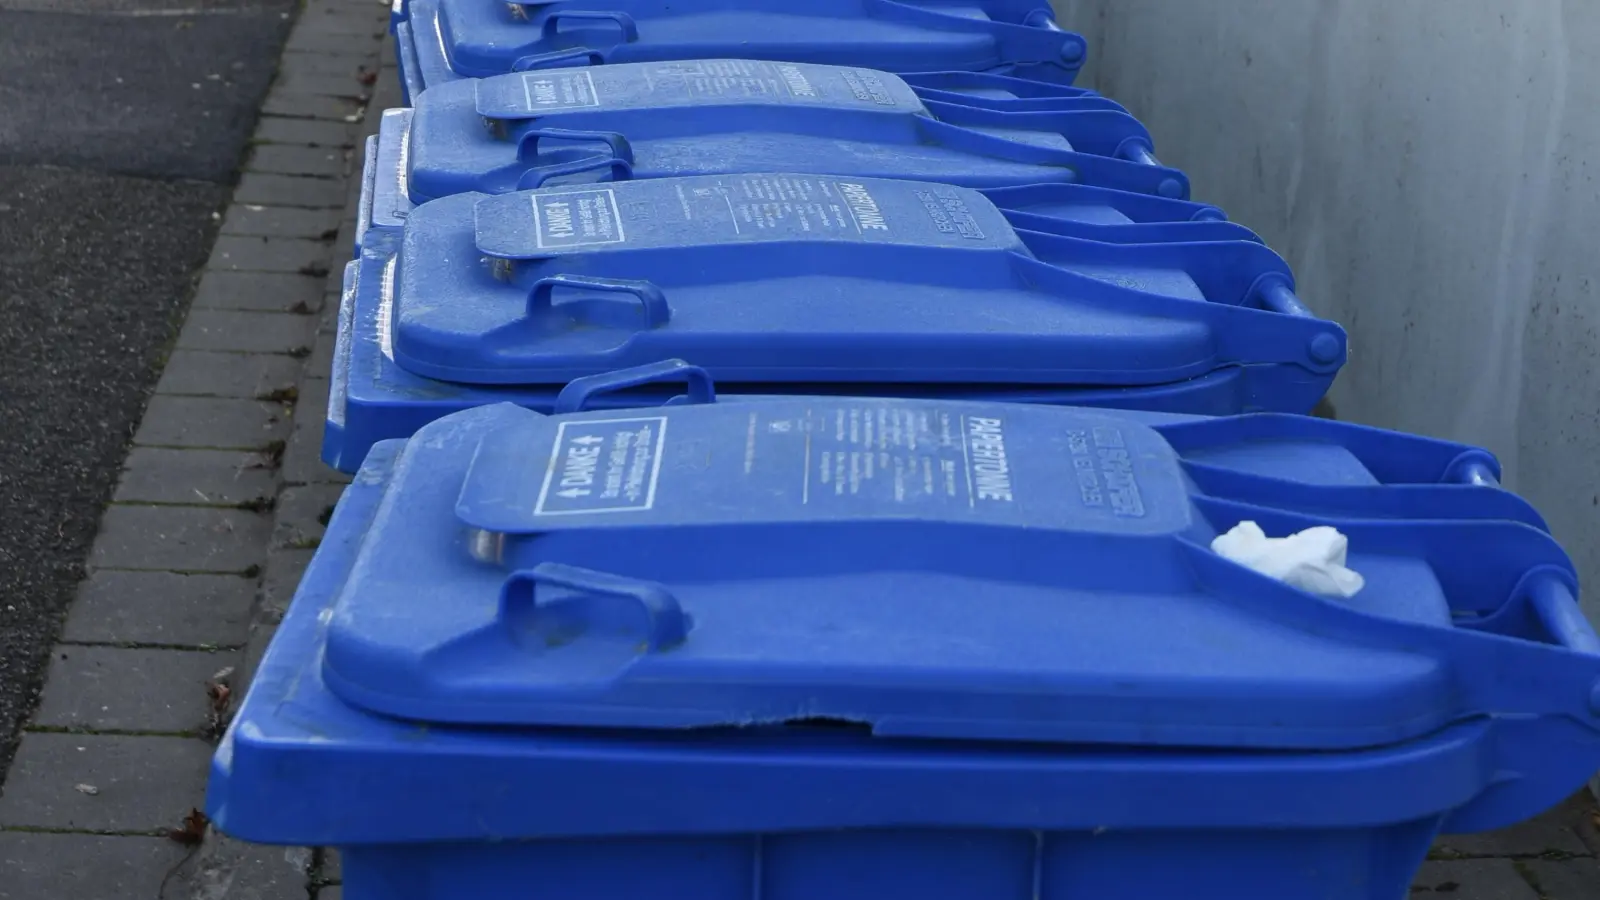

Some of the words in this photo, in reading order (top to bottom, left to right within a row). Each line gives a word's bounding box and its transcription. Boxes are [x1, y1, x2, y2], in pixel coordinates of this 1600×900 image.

[546, 208, 573, 232] DANKE
[560, 446, 601, 487] DANKE
[969, 416, 1012, 501] PAPIERTONNE
